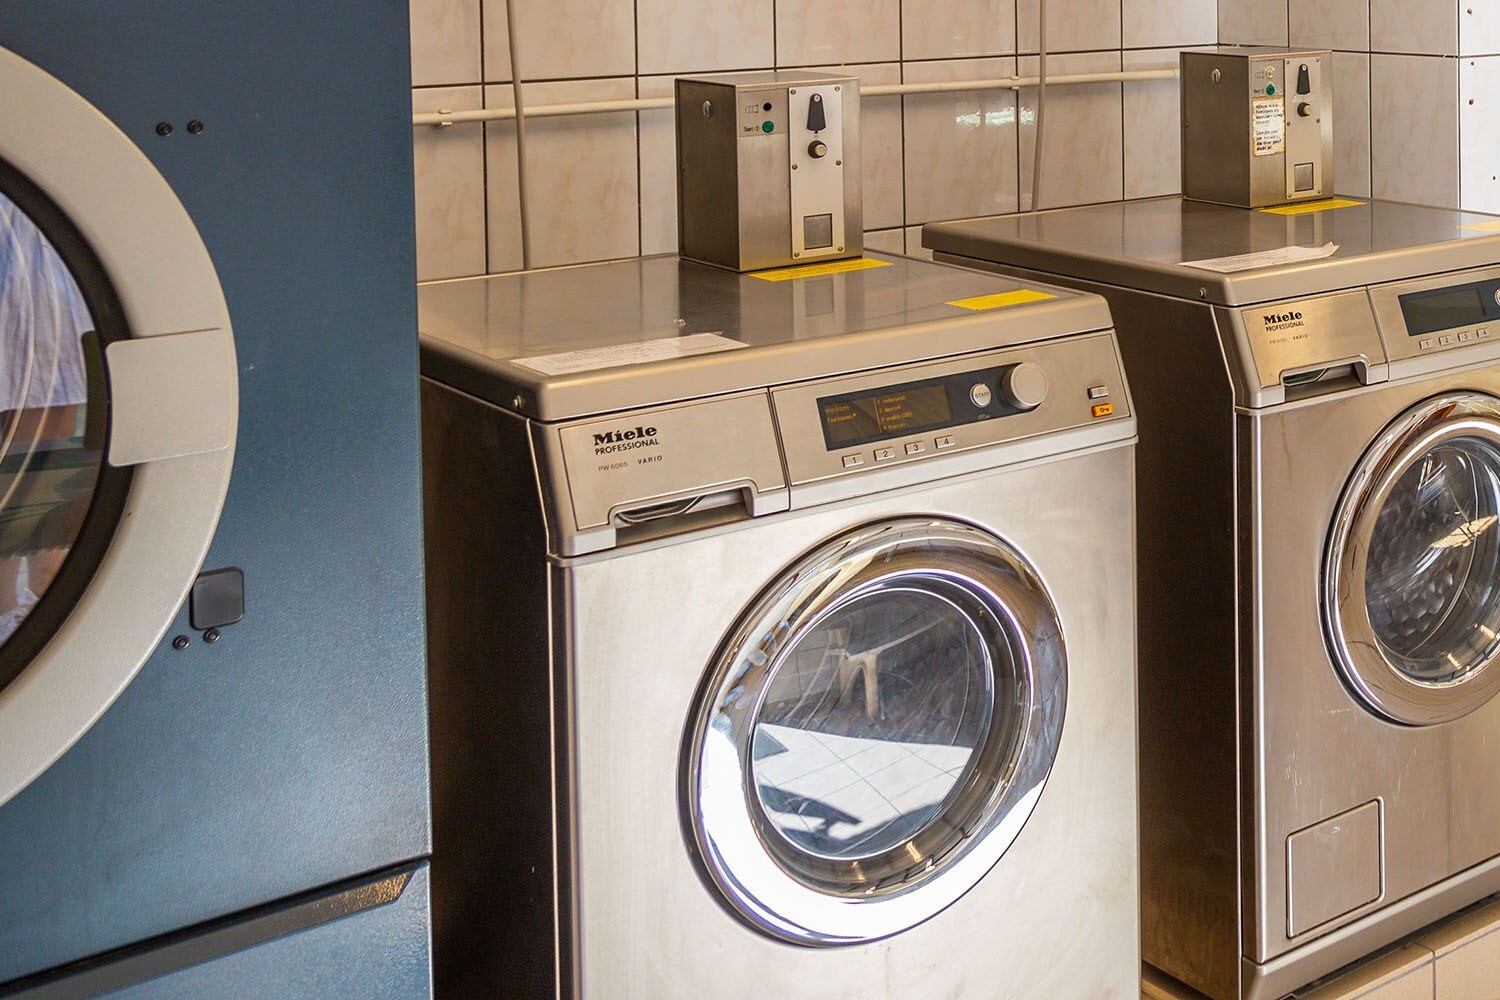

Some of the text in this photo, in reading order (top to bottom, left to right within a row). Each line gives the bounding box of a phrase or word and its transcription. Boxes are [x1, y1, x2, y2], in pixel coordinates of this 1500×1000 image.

[1263, 311, 1303, 325] Miele
[1265, 320, 1305, 332] PROFESSIONAL
[593, 426, 658, 447] Miele
[595, 438, 660, 456] PROFESSIONAL
[637, 455, 663, 464] VARIO
[852, 456, 857, 464] 1
